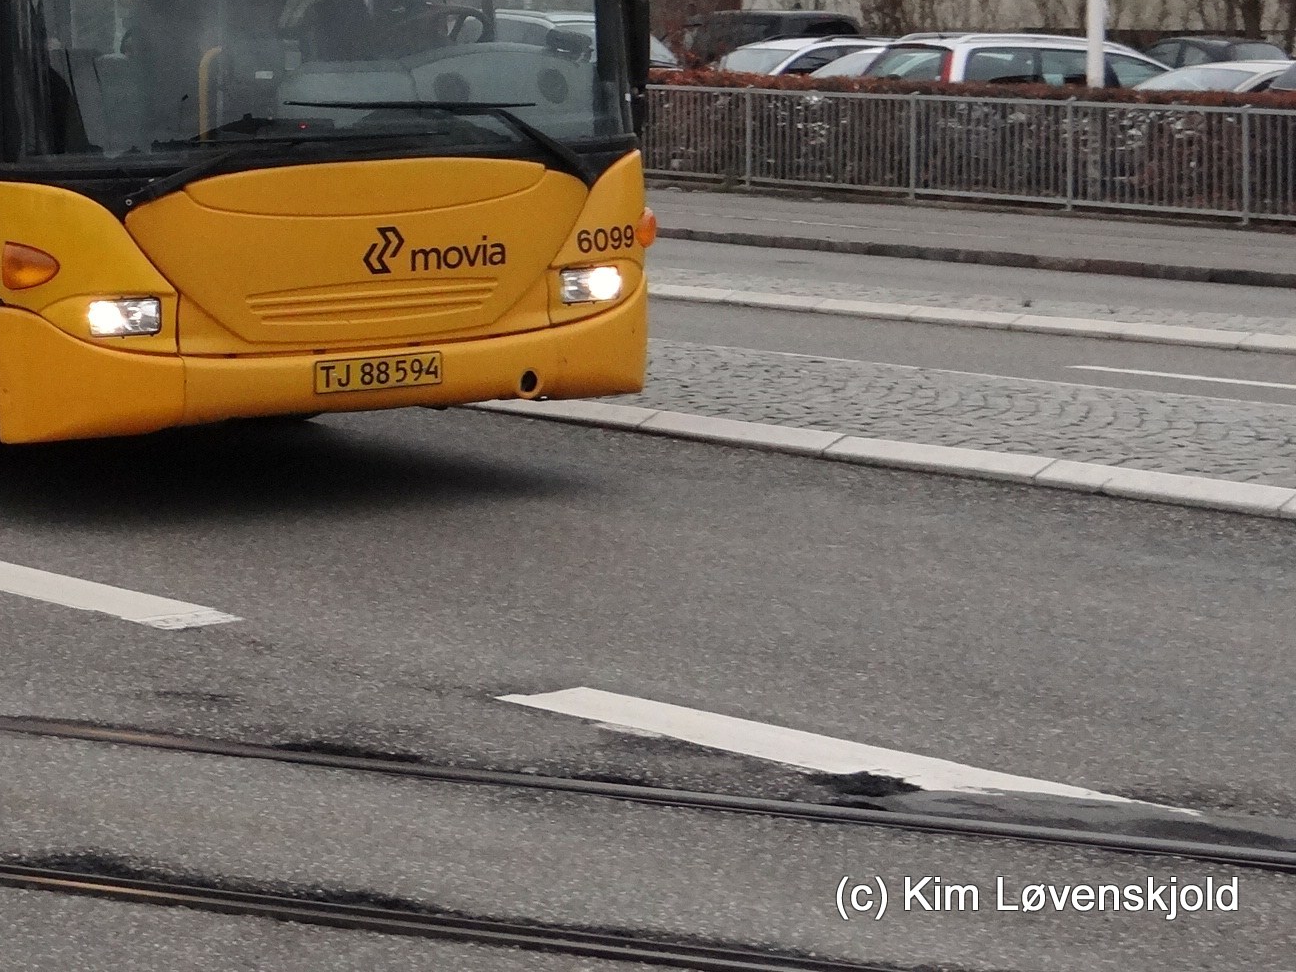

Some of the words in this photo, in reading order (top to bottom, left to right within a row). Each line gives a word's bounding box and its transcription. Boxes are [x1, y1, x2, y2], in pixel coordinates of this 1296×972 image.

[410, 235, 506, 271] movia
[577, 224, 635, 253] 6099
[320, 364, 350, 388] TJ
